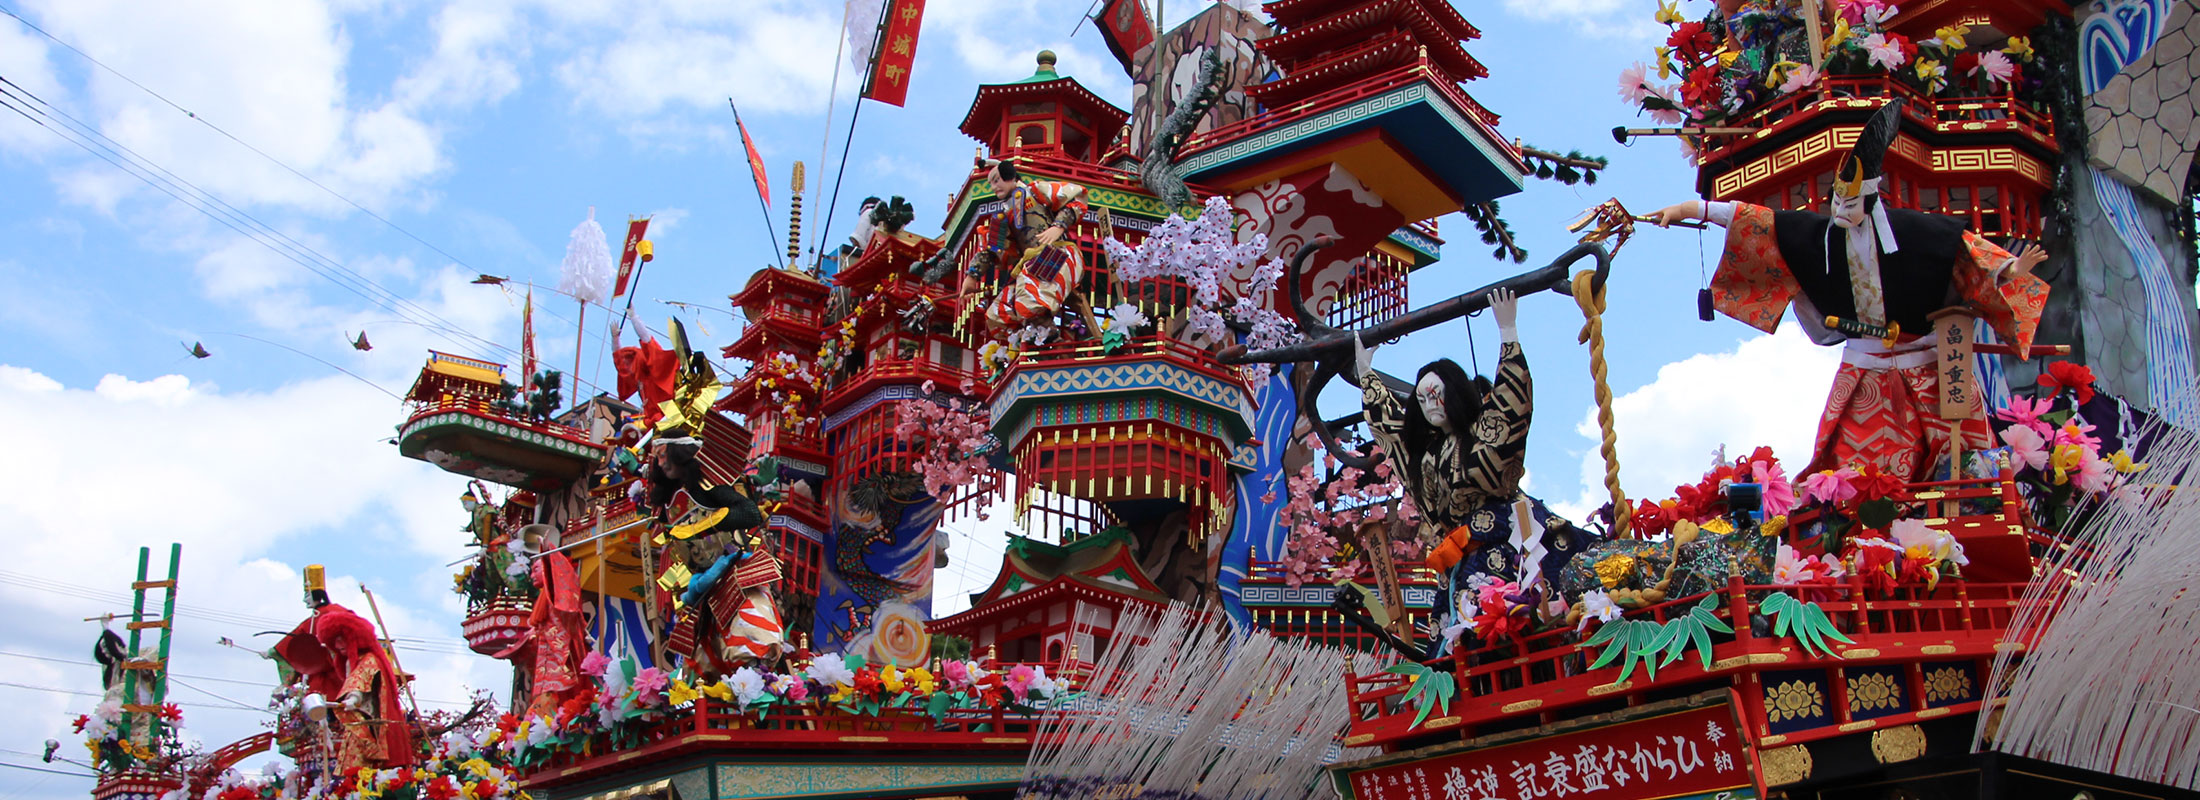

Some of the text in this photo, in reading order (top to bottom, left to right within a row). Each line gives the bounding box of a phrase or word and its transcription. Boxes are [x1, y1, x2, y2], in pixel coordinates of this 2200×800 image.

[886, 3, 918, 88] 中城町
[1944, 323, 1966, 405] 畠山重忠
[1509, 735, 1705, 800] ひらかな盛衰記
[1705, 720, 1735, 774] 奉納
